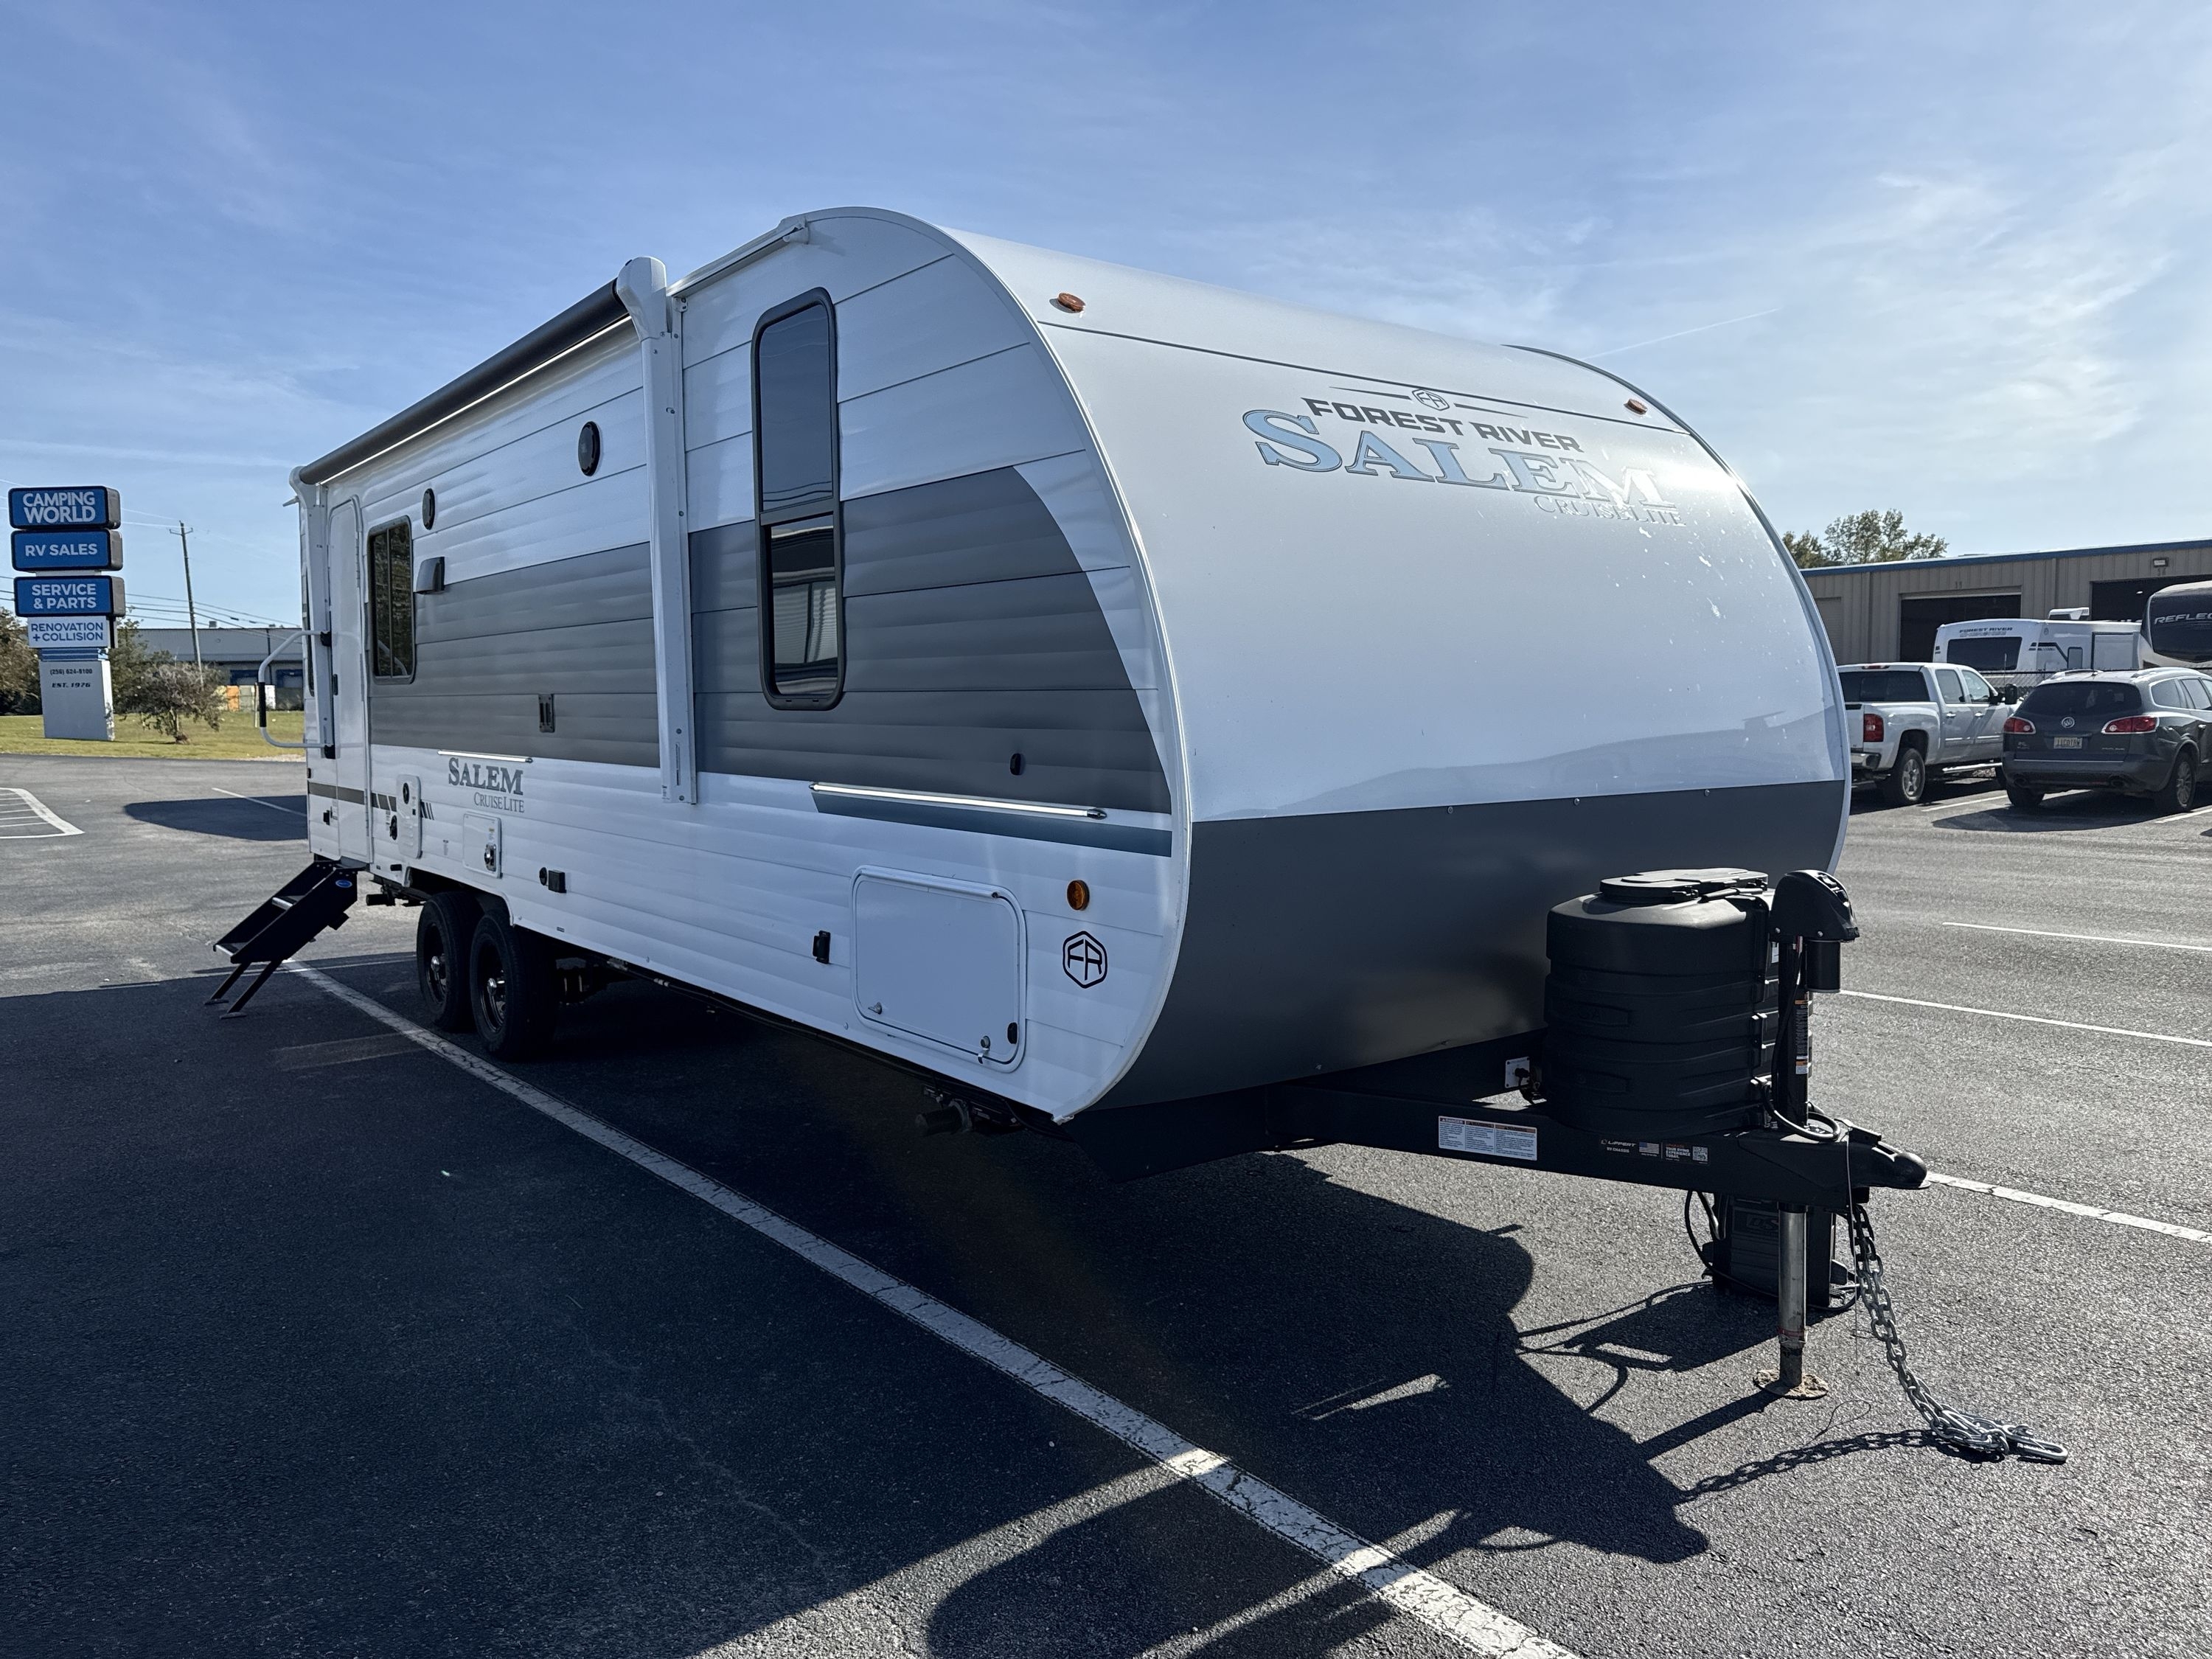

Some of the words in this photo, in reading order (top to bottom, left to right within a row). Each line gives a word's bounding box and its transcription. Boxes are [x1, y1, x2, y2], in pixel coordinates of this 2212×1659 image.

[1301, 397, 1464, 436] FOREST
[1469, 421, 1584, 453] RIVER
[1242, 409, 1678, 509] SALEM
[23, 491, 95, 507] CAMPING
[24, 506, 96, 524] WORLD
[25, 544, 46, 557] RV
[49, 543, 97, 556] SALES
[32, 583, 97, 596] SERVICE
[33, 598, 43, 609] &
[46, 597, 97, 609] PARTS
[31, 622, 103, 632] RENOVATION
[448, 757, 524, 796] SALEM
[473, 792, 525, 813] CRUISELITE
